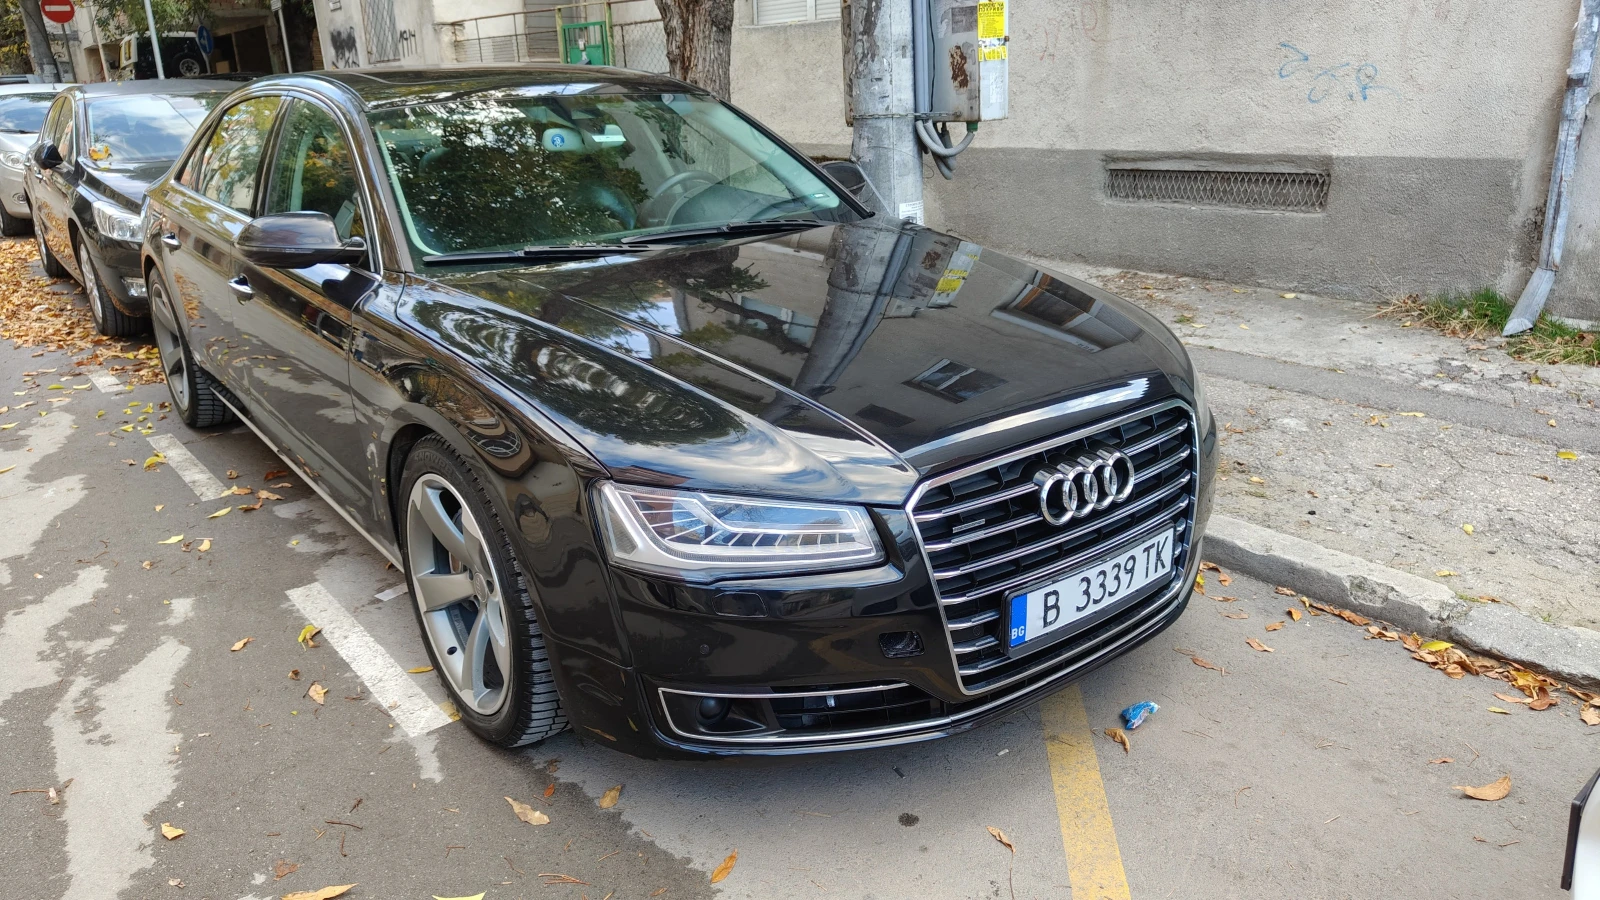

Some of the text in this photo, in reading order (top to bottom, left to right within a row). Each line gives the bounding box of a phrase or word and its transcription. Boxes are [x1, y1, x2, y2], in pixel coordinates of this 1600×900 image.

[1042, 535, 1169, 629] B 3339 TK
[1011, 625, 1025, 640] BG
